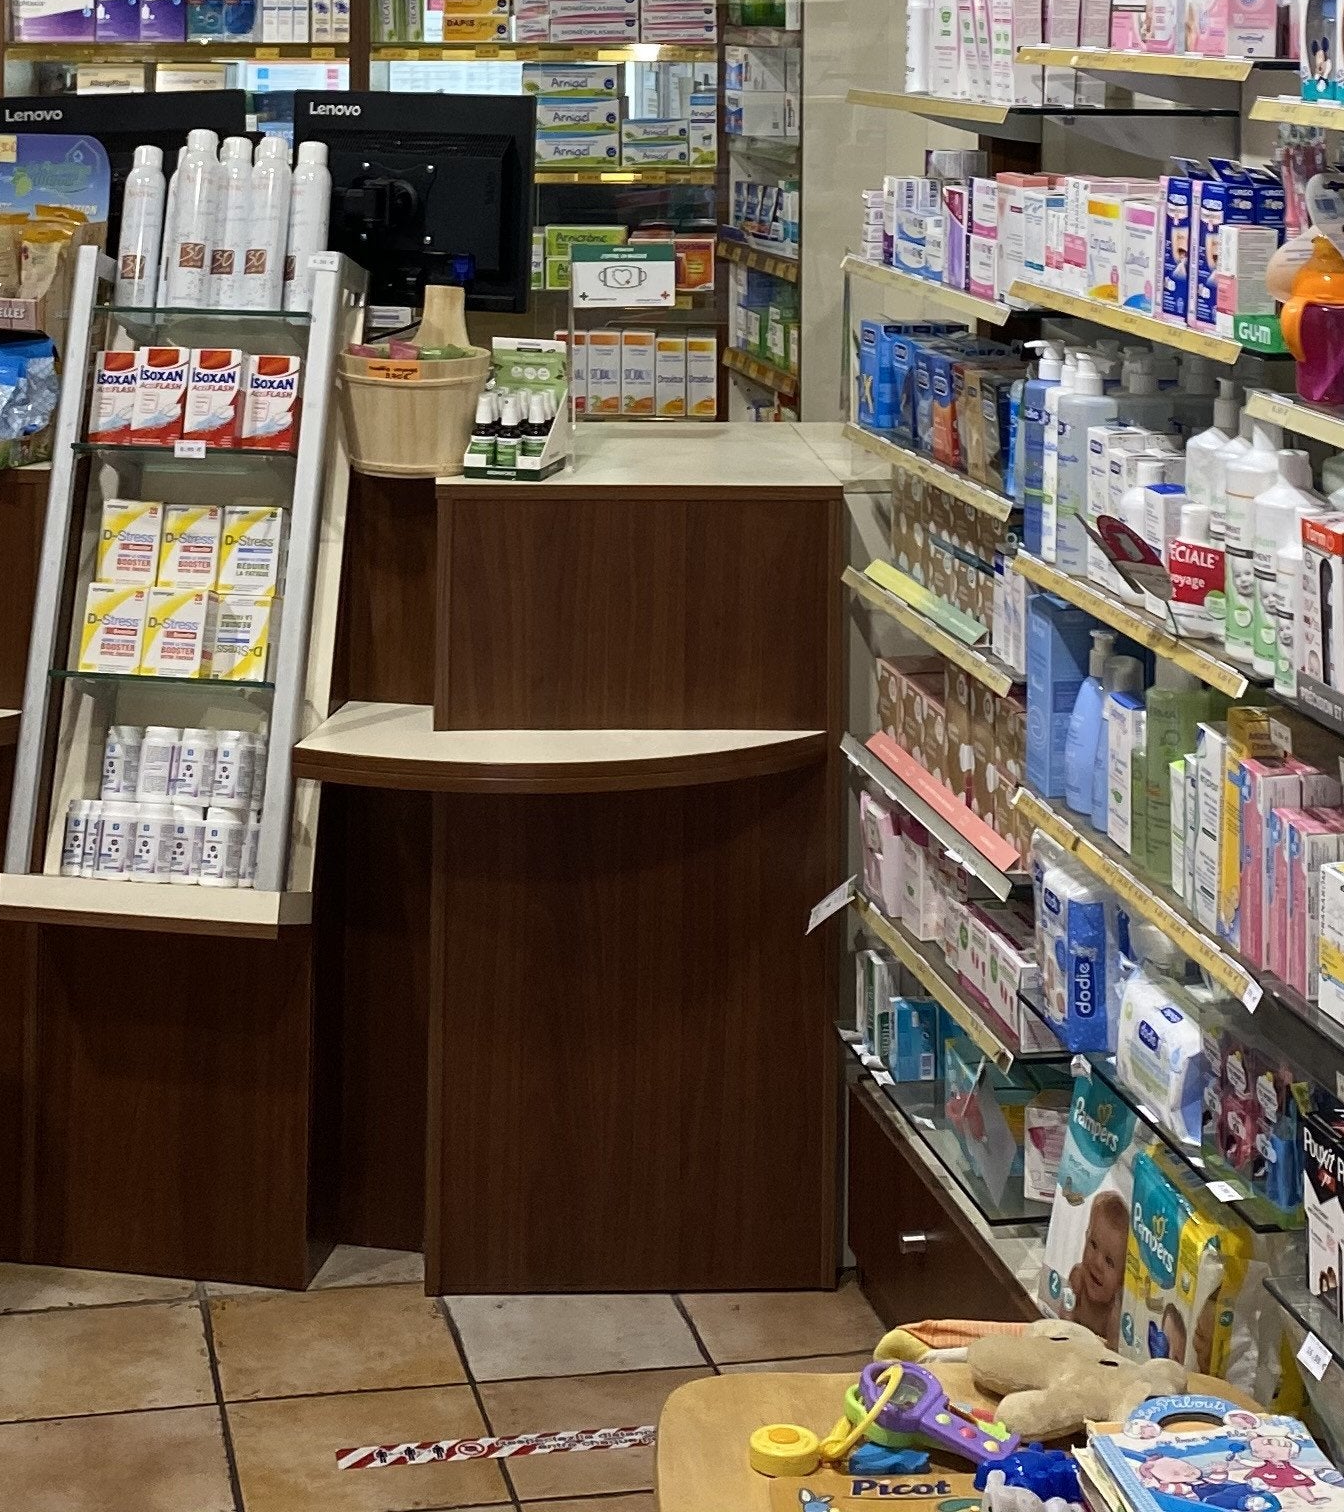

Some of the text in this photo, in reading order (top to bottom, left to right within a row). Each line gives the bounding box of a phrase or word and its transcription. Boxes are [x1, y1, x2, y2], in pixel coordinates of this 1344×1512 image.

[5, 109, 63, 122] Lenovo
[309, 102, 361, 116] Lenovo
[180, 243, 204, 260] 30
[212, 250, 235, 267] 30
[245, 250, 266, 267] 30
[97, 369, 137, 385] ISOXAN
[140, 365, 184, 382] ISOXAN
[192, 367, 235, 384] ISOXAN
[251, 374, 294, 390] ISOXAN
[104, 530, 154, 543] D-Stress
[166, 533, 214, 544] D-Stress
[225, 535, 273, 547] D-Stress
[117, 559, 151, 567] BOOSTER
[88, 613, 140, 627] D-Stress
[148, 617, 199, 630] D-Stress
[161, 647, 195, 655] BOOSTER
[1076, 962, 1092, 1015] dodie
[1073, 1095, 1120, 1151] Pampers
[1304, 1126, 1335, 1172] Pouxit
[1133, 1201, 1174, 1272] Pampers
[850, 1477, 951, 1499] Picot
